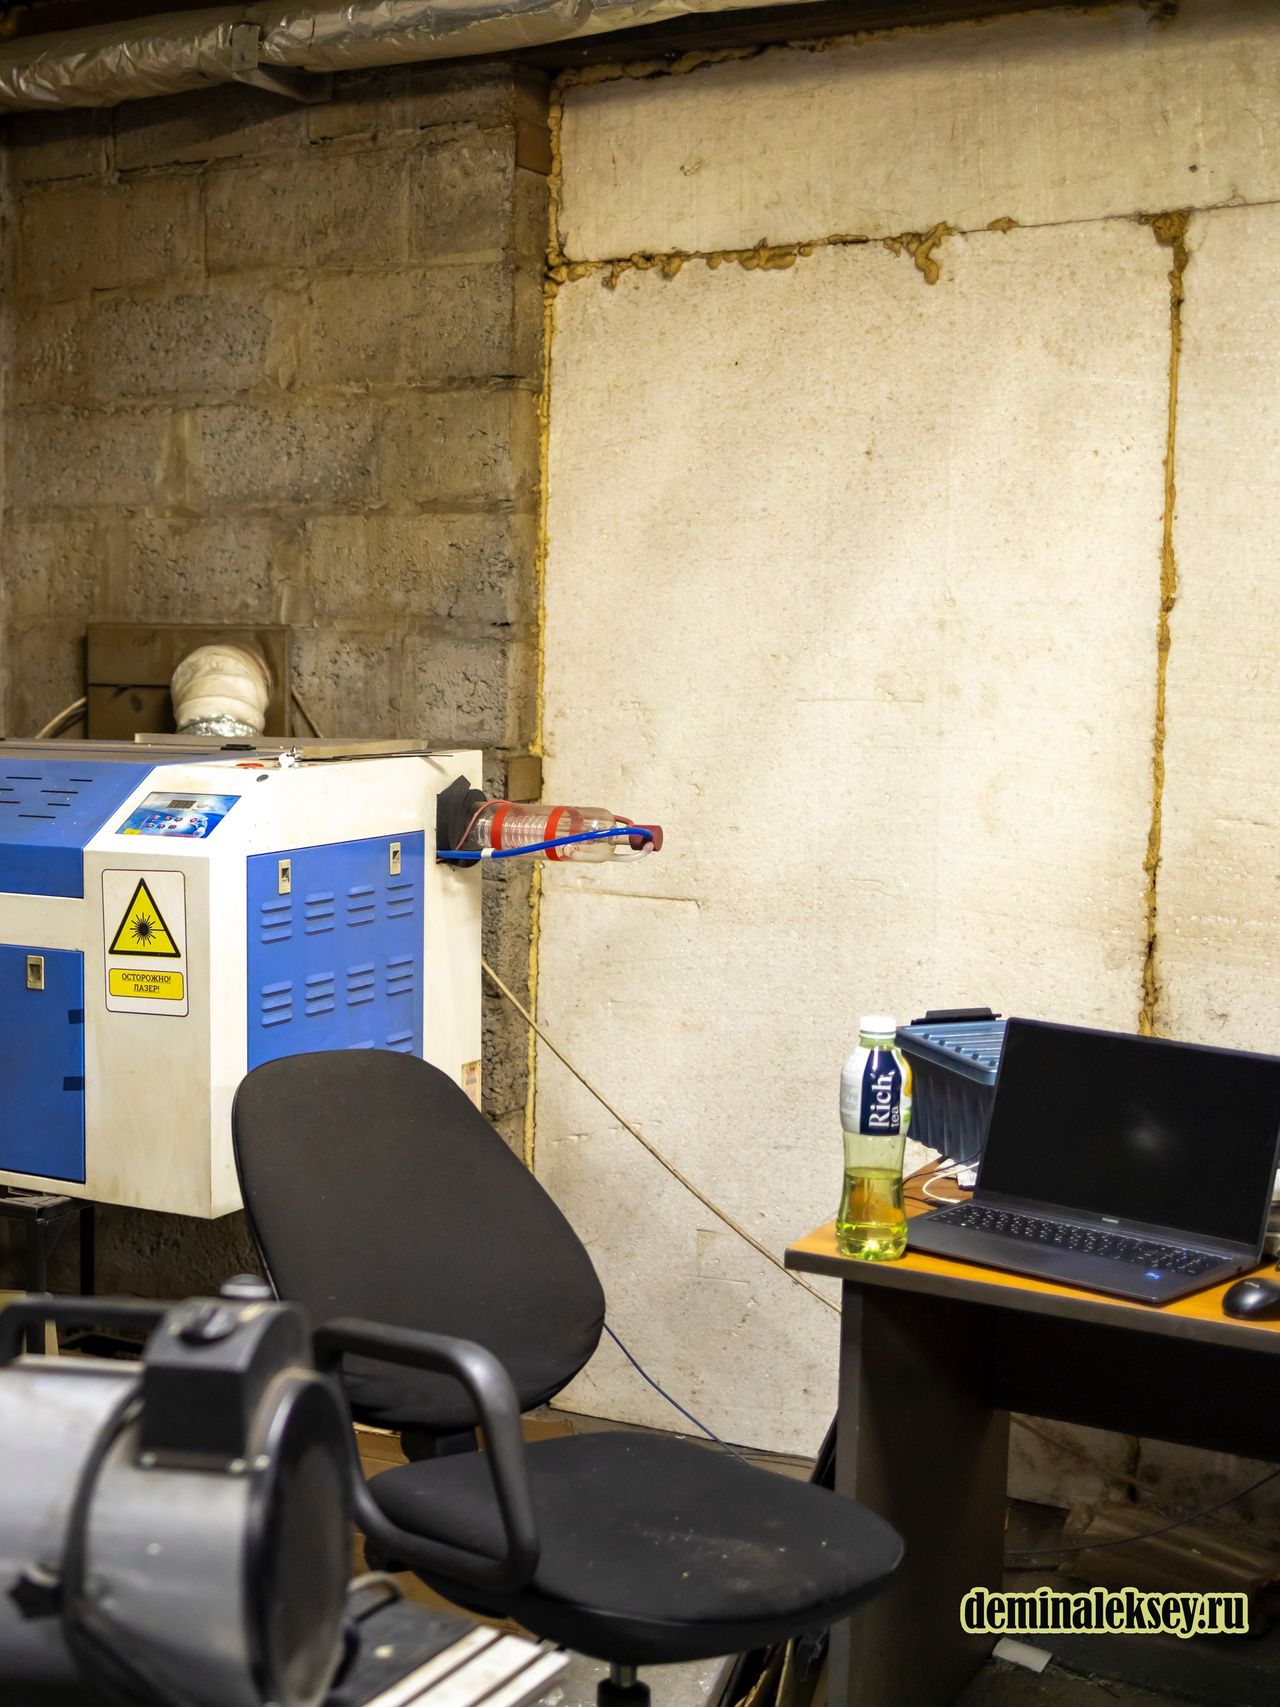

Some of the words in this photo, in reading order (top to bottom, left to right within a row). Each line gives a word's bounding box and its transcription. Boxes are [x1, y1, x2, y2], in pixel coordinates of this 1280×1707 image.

[121, 973, 171, 983] ОСТОРОЖНО!
[133, 984, 160, 993] ЛАЗЕР!
[868, 1075, 893, 1128] Rich
[891, 1105, 900, 1128] tea
